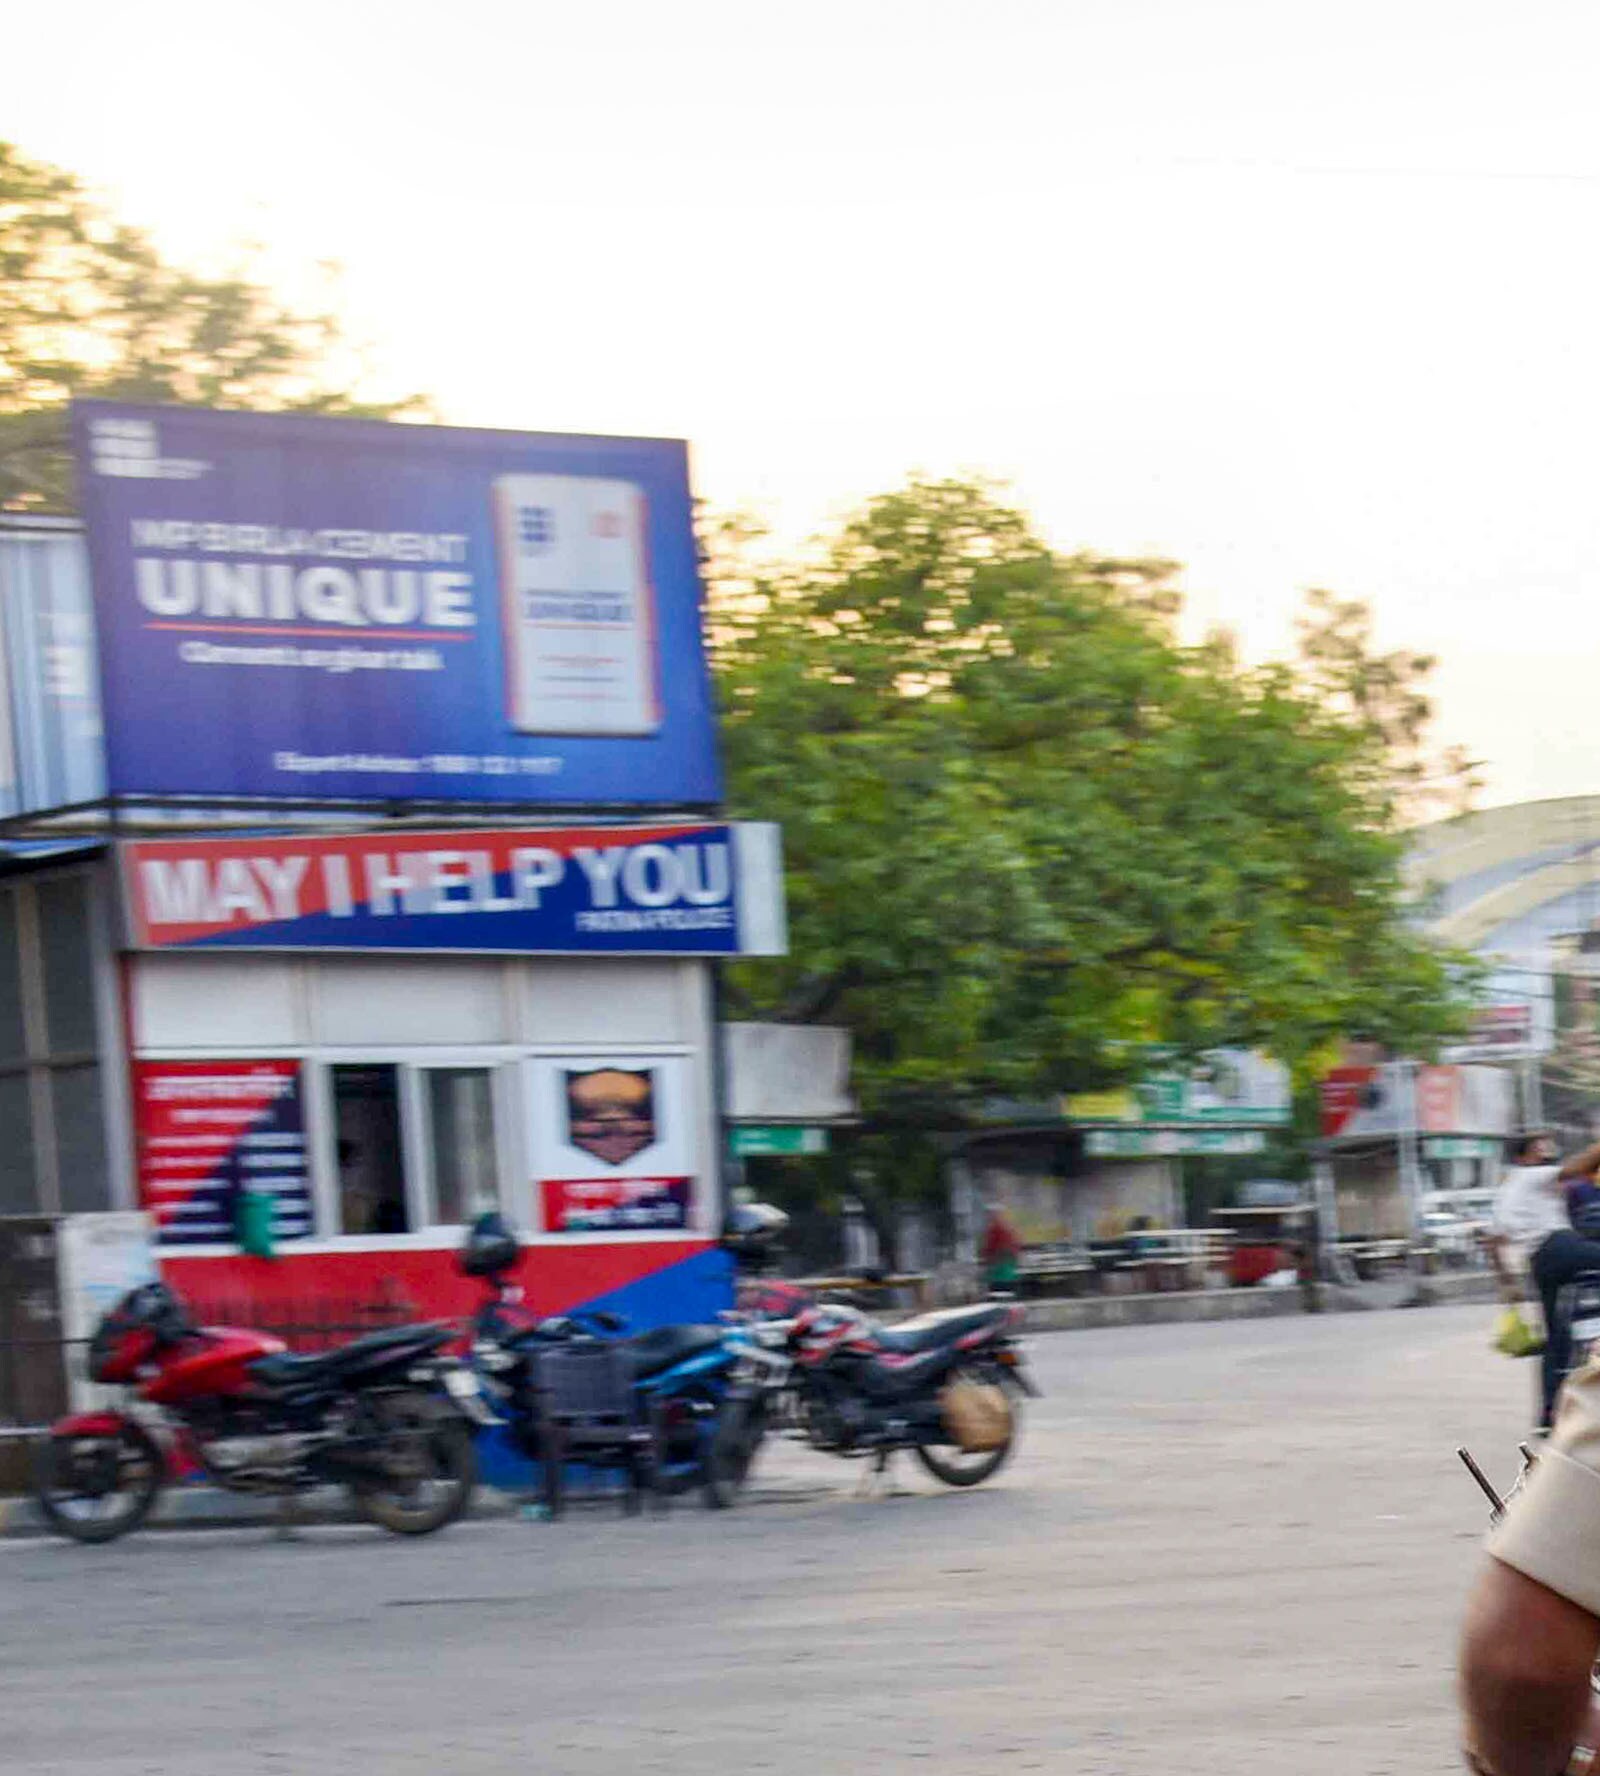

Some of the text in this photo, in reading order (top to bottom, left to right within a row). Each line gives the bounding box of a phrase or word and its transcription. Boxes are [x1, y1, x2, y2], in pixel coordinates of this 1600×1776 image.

[133, 557, 478, 627] UNIQUE
[139, 841, 735, 926] MAY I HELP YOU
